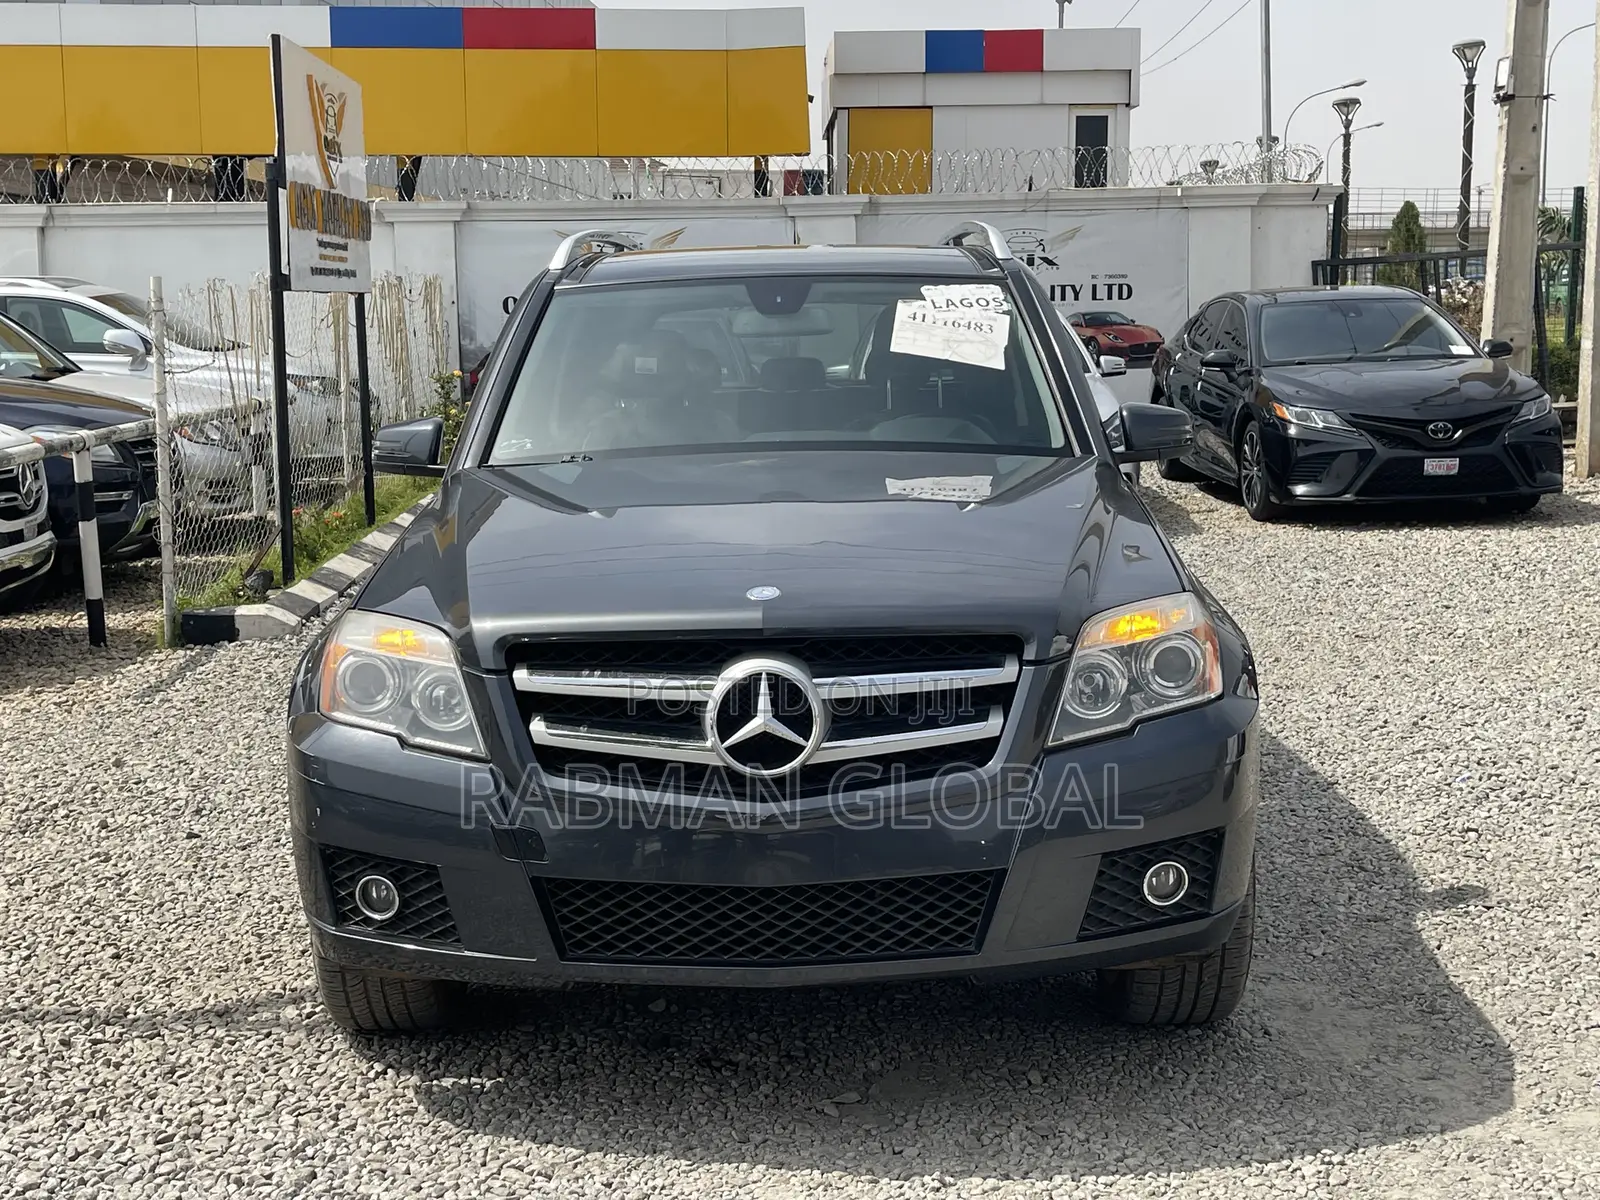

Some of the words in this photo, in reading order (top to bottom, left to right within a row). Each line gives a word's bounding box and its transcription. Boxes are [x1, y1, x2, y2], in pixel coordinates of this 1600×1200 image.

[1049, 283, 1084, 302] ITY
[1091, 283, 1133, 301] LTD
[930, 296, 1005, 310] LAGOS
